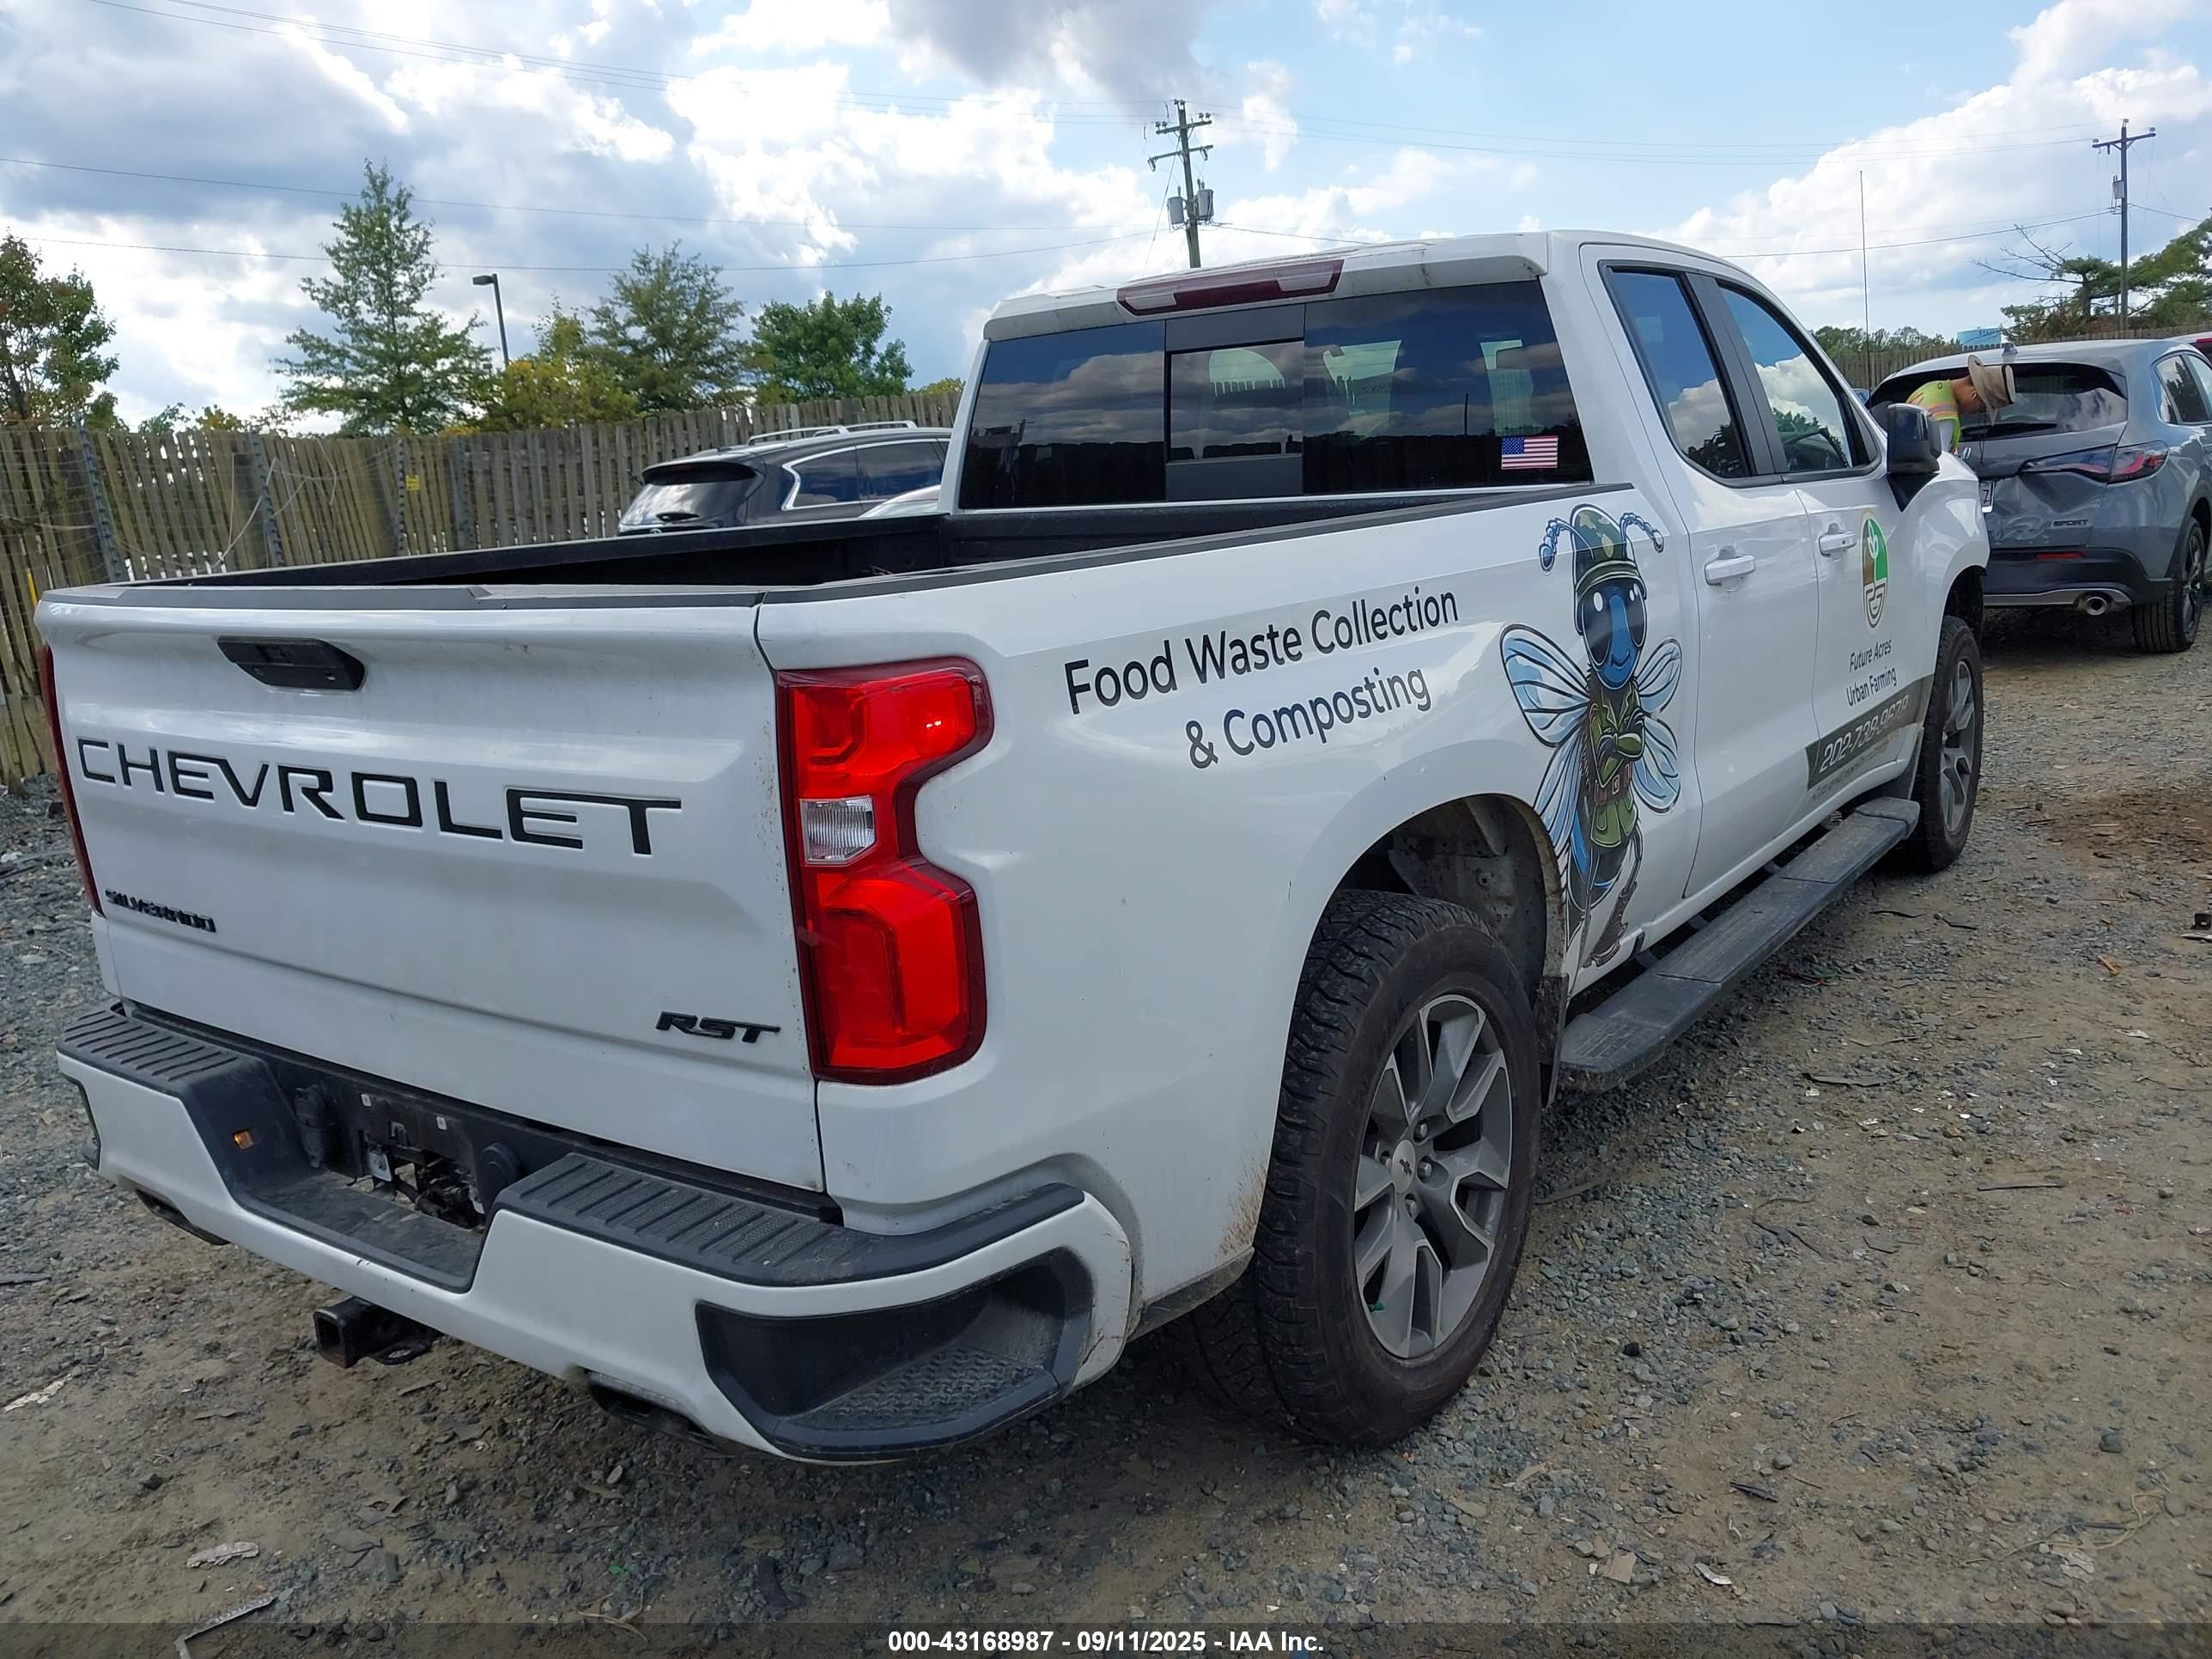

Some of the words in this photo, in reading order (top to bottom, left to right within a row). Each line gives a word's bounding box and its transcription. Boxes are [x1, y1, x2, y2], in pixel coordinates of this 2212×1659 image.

[1064, 639, 1178, 714] Food
[1185, 623, 1303, 684] Waste
[1311, 586, 1459, 654] Collection
[1849, 647, 1873, 674] Future
[1873, 638, 1892, 661] Acres
[1845, 682, 1870, 707] Urban
[1869, 665, 1897, 695] Farming
[1185, 720, 1218, 769] &
[1223, 666, 1431, 757] Composting
[76, 738, 682, 856] CHEVROLET
[105, 889, 217, 933] SILVERADO
[655, 1011, 781, 1044] RST
